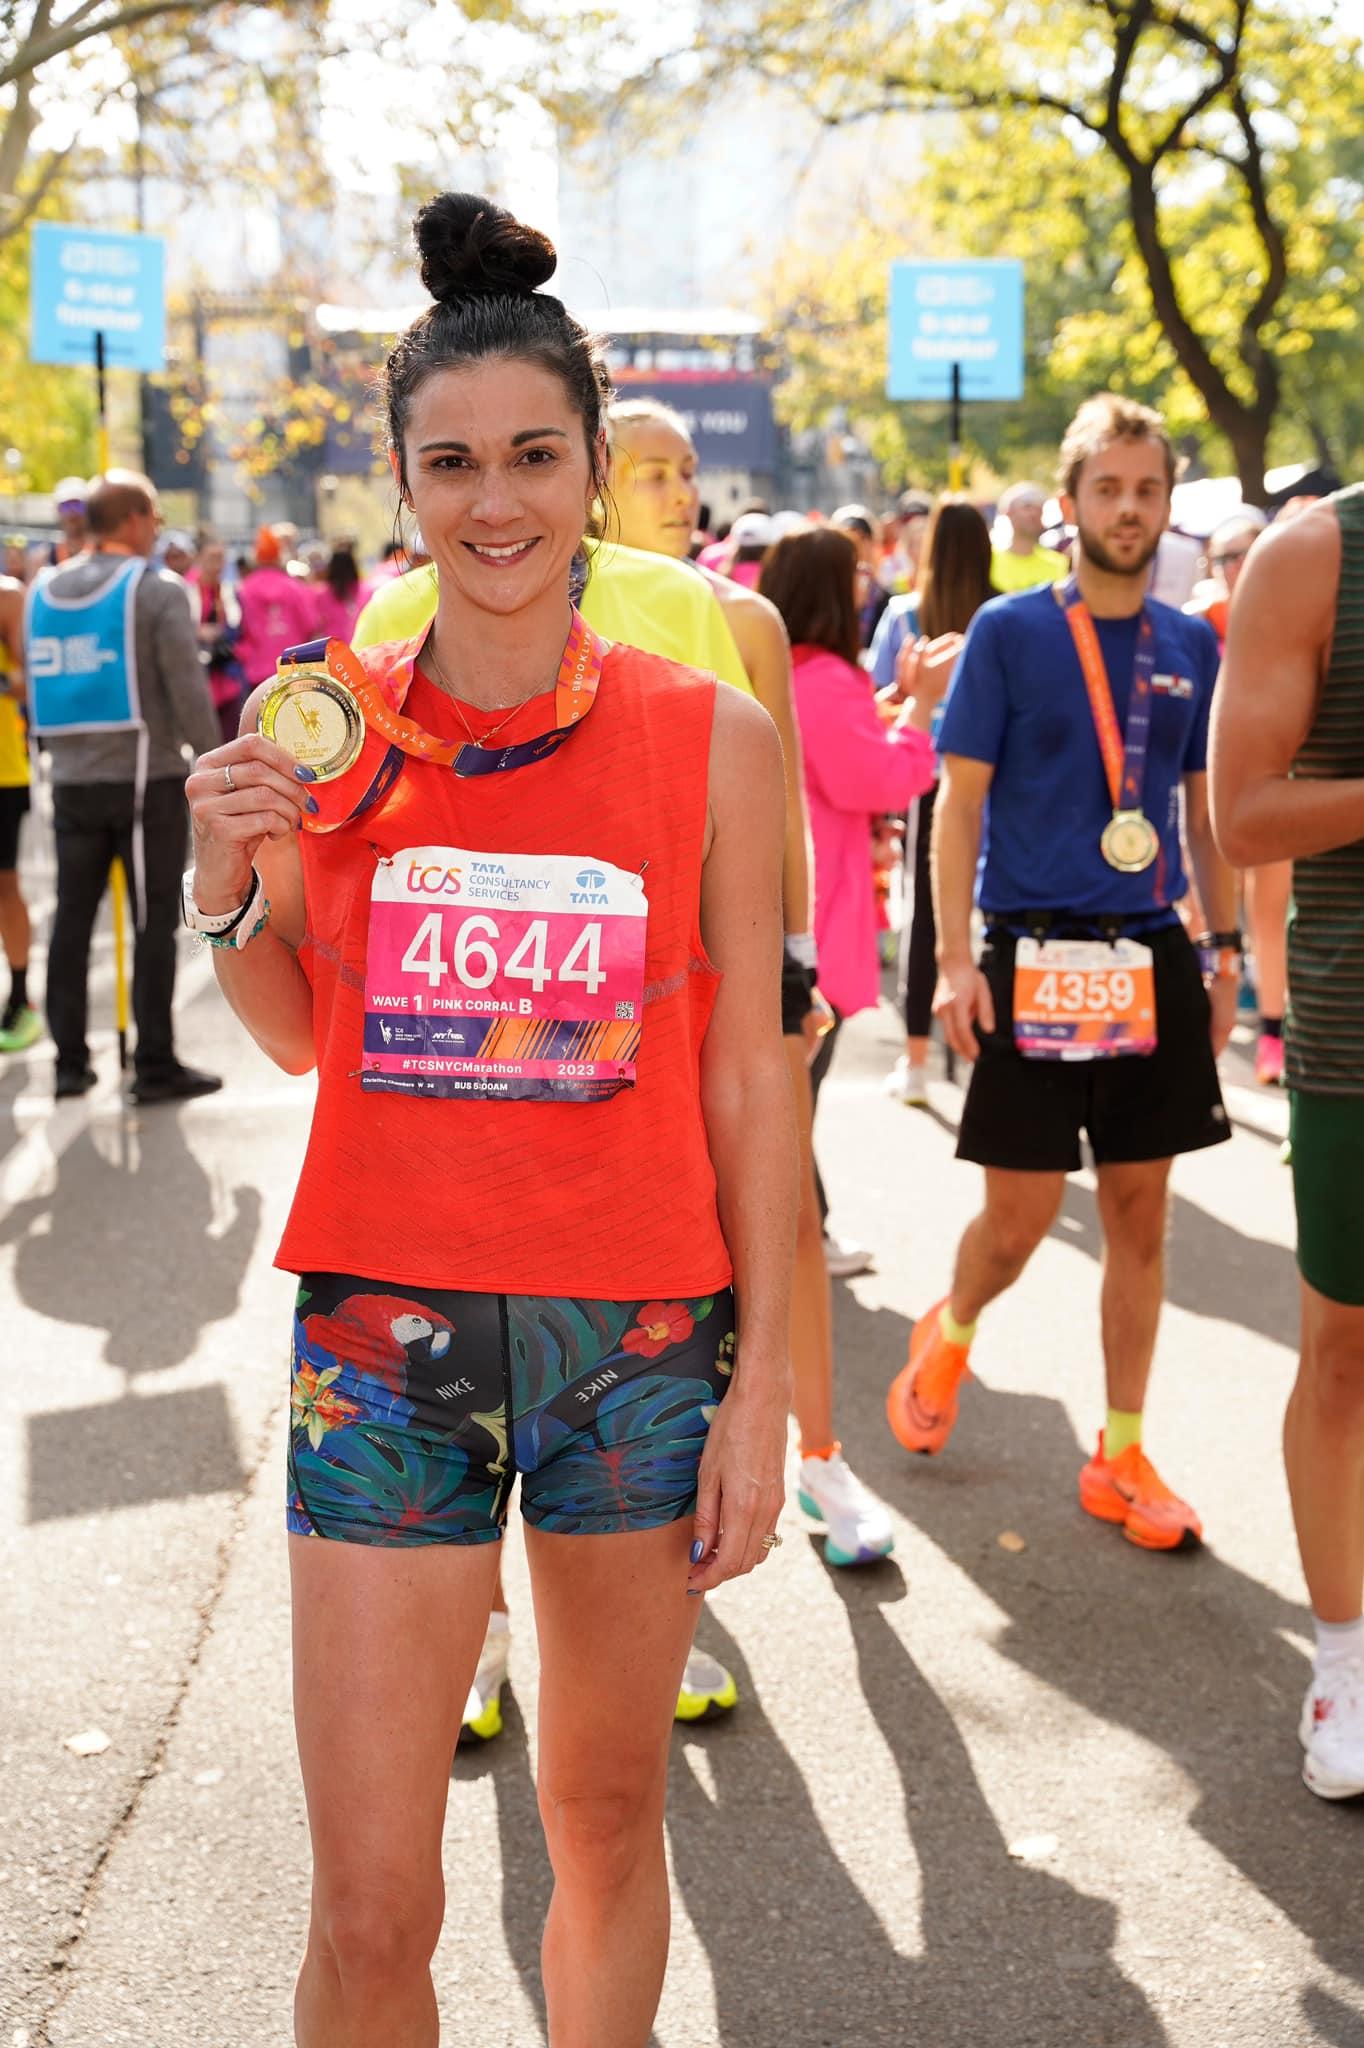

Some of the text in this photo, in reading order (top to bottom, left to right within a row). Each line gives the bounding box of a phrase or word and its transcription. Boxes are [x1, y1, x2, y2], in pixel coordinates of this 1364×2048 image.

[572, 632, 591, 692] BROOKLYN
[335, 663, 374, 709] ISLAND
[375, 712, 426, 748] STATEN
[470, 862, 506, 875] TATA
[469, 874, 550, 890] CONSULTANCY
[468, 886, 520, 902] SERVICES
[569, 892, 609, 905] TATA
[401, 911, 607, 995] 4644
[1033, 971, 1136, 1012] 4359
[372, 994, 533, 1015] WAVE 1 PINK CORRAL B
[402, 1060, 596, 1076] #TCSNYCMarathon 2023
[454, 1081, 508, 1091] BUS 5:00AM
[434, 1377, 476, 1400] NIKE
[575, 1369, 619, 1403] NIKE
